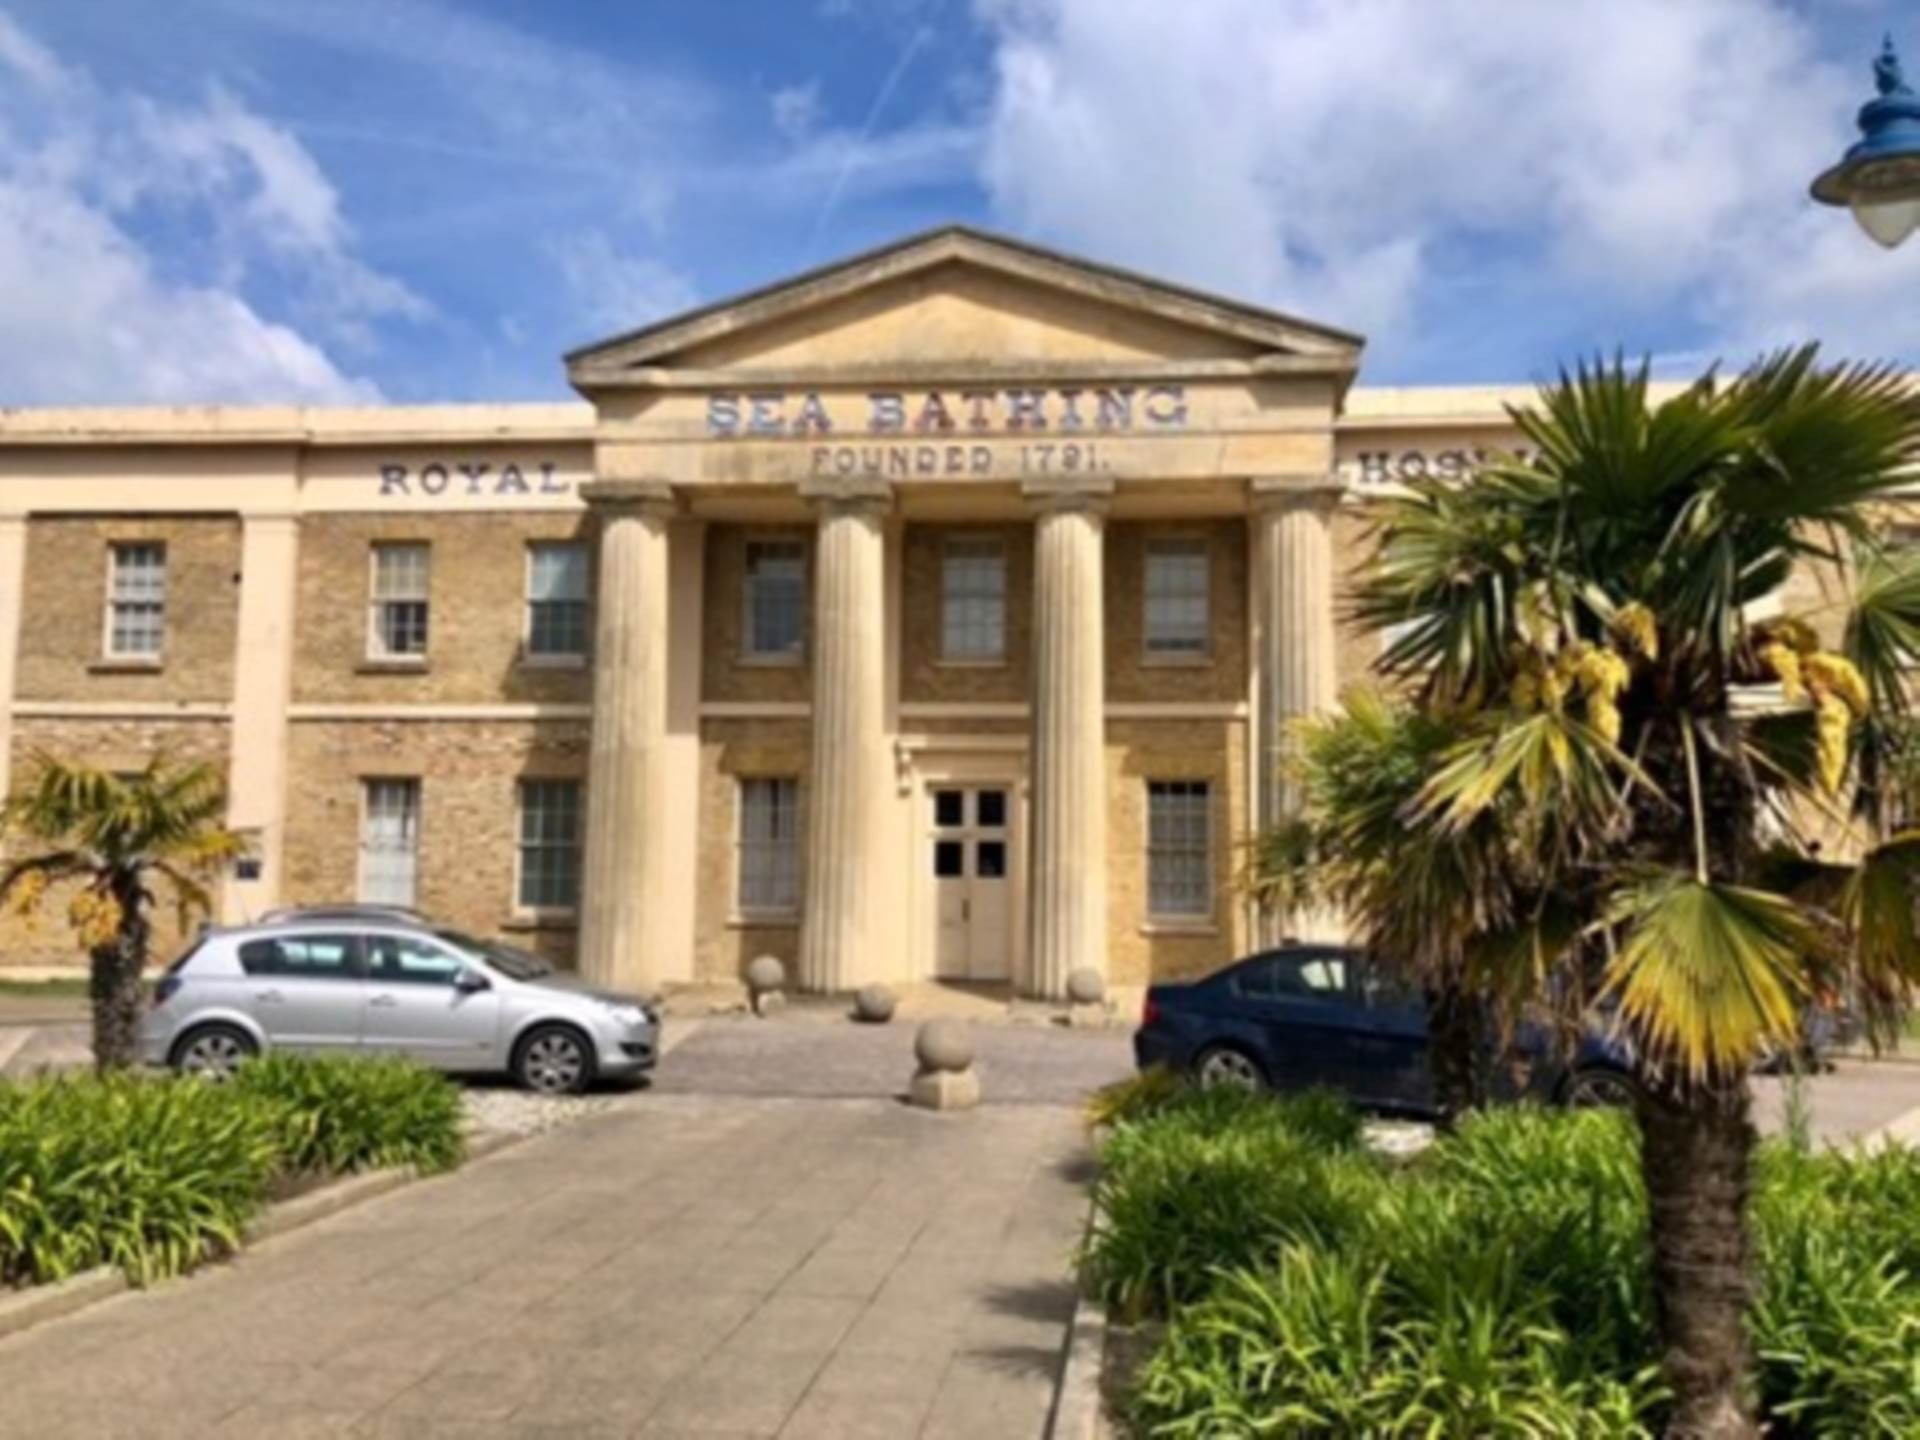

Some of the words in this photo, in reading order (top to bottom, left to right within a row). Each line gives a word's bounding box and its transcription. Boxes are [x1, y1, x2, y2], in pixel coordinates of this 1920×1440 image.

[707, 390, 832, 436] SEA
[868, 387, 1188, 433] BATHING
[812, 446, 992, 474] FOUNDED
[379, 462, 570, 495] ROYAL
